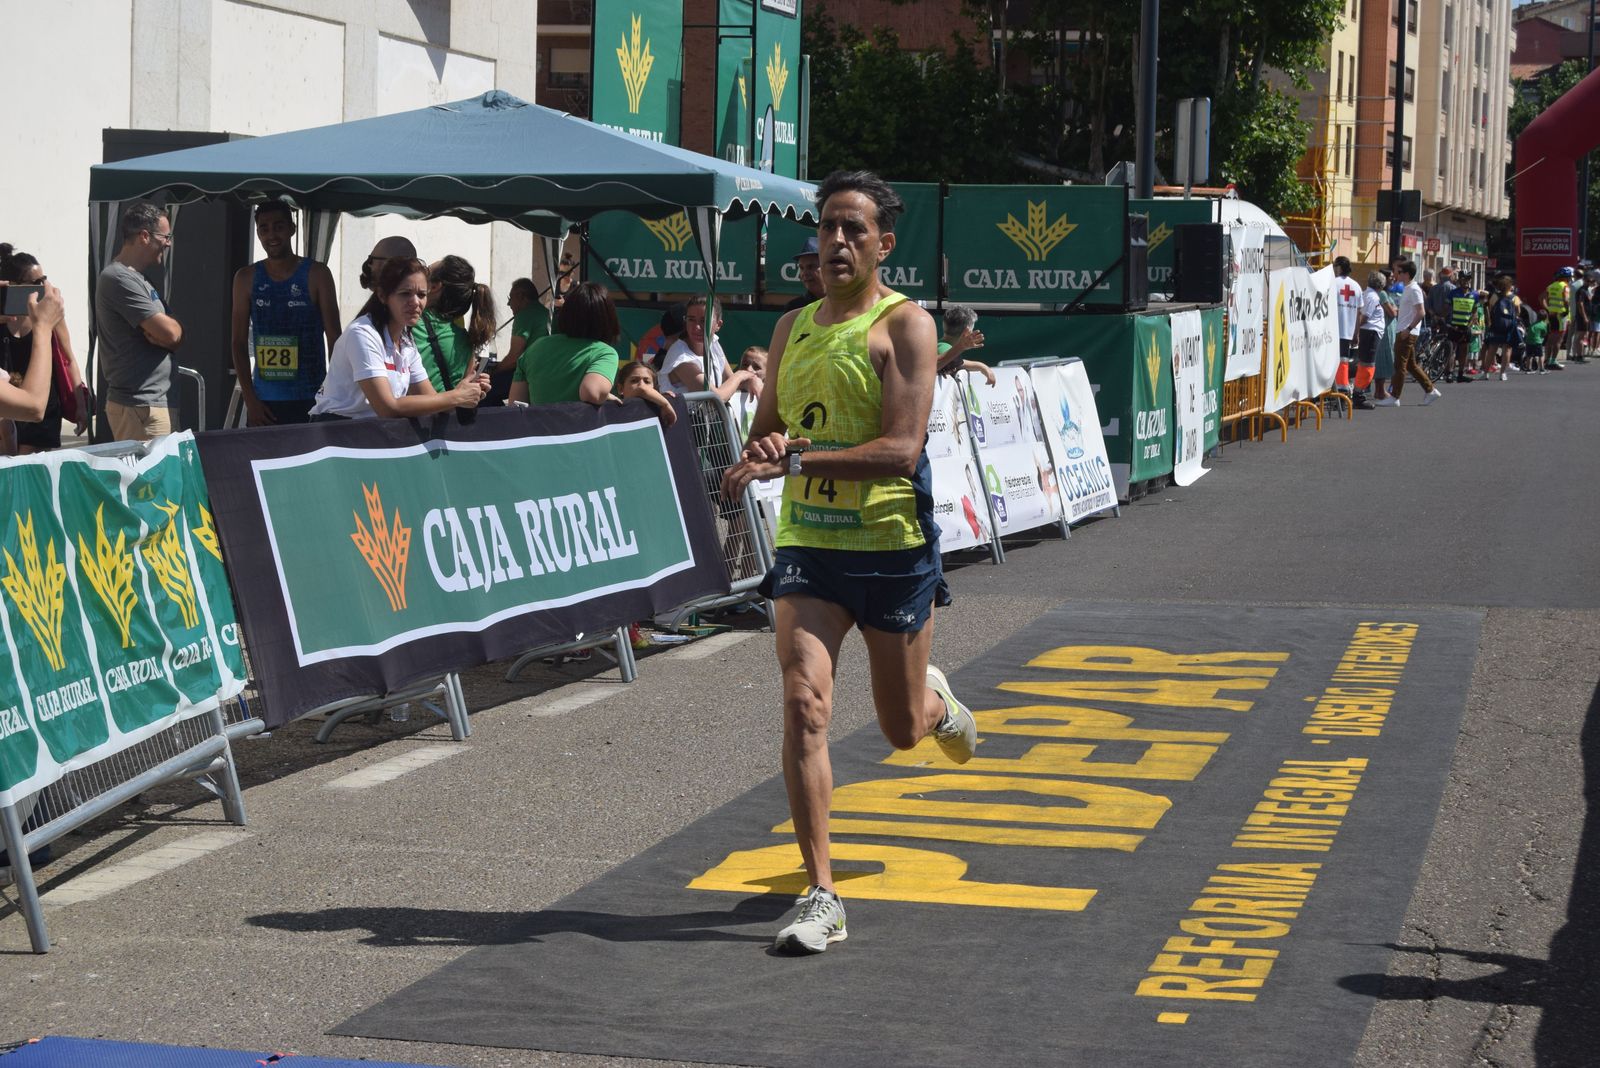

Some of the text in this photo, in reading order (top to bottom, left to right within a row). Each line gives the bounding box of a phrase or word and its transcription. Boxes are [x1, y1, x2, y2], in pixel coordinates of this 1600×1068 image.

[775, 120, 796, 145] RURAL
[1531, 242, 1570, 251] ZAMORA
[604, 257, 657, 279] CAJA
[877, 266, 924, 287] RAL
[963, 269, 1110, 290] CAJA RURAL
[259, 348, 291, 367] 128
[1058, 455, 1110, 502] OCEANIC
[803, 511, 857, 524] CAJA RURAL
[423, 486, 639, 593] CAJA RURAL
[58, 677, 98, 713] RURAL
[1135, 862, 1323, 1002] REFORMA
[1231, 756, 1369, 852] INTEGRAL
[1329, 621, 1420, 684] INTERIORES
